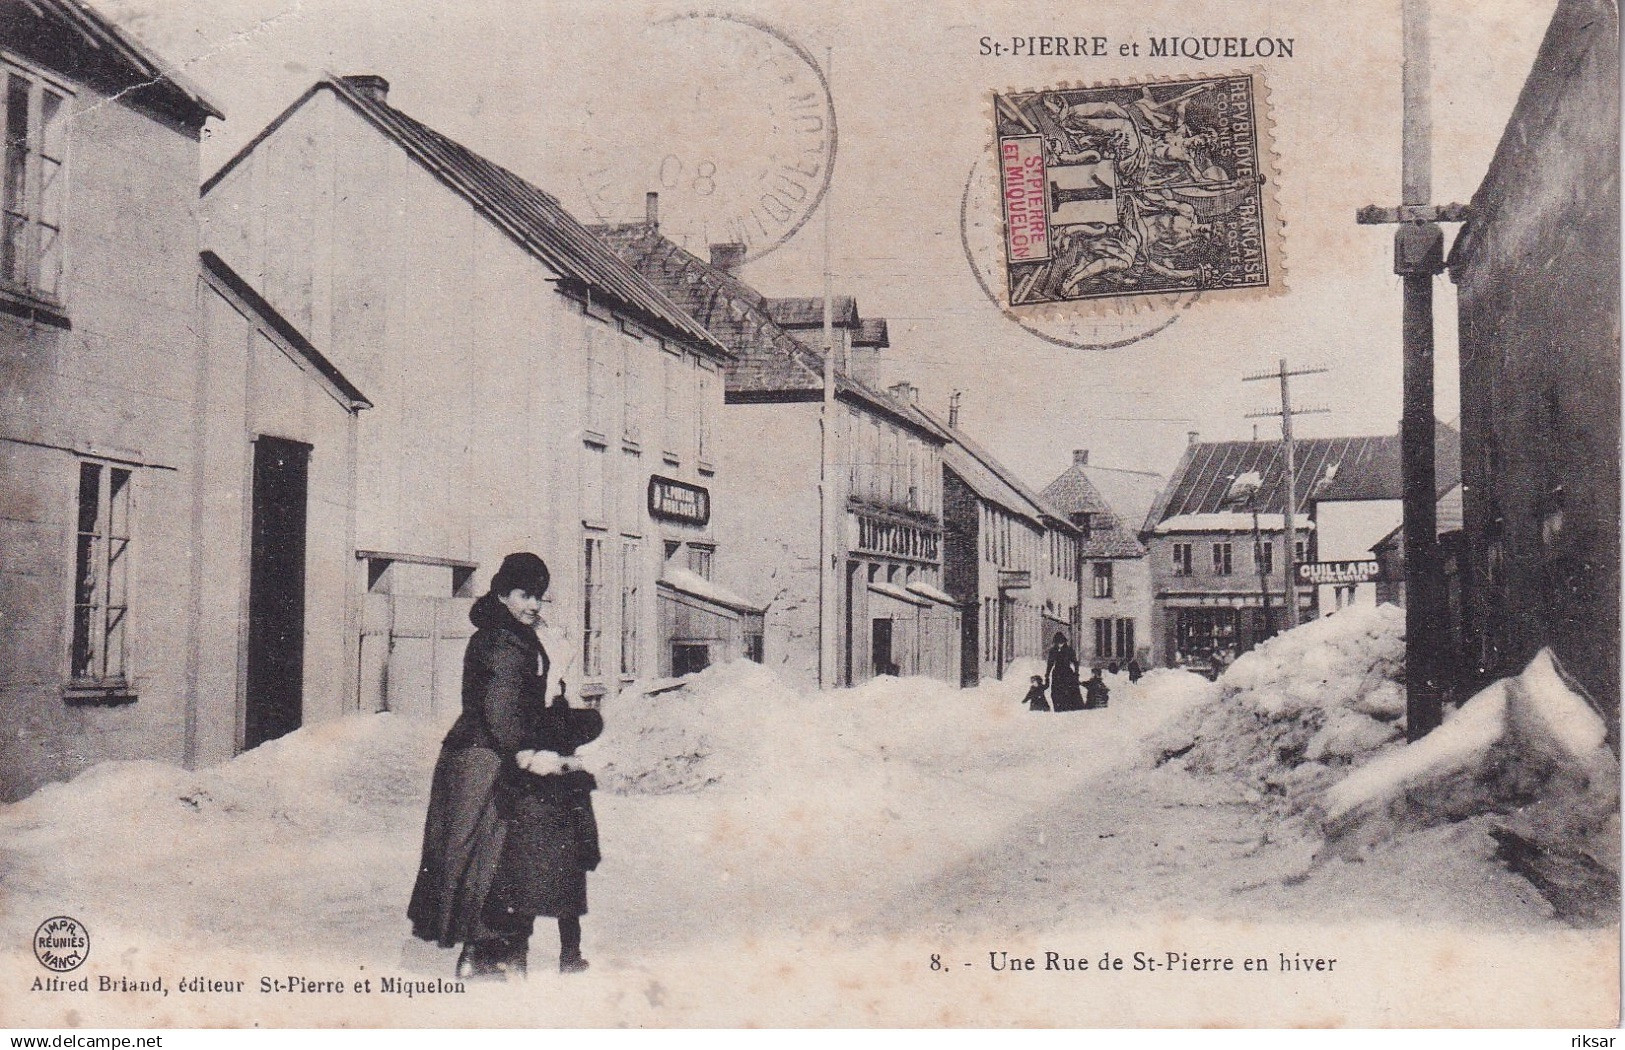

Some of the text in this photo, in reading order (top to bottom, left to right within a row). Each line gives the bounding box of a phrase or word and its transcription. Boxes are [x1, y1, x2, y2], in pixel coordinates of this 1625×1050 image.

[1004, 144, 1031, 258] ET MIQUELON
[1217, 92, 1242, 273] COLONIES POSTES
